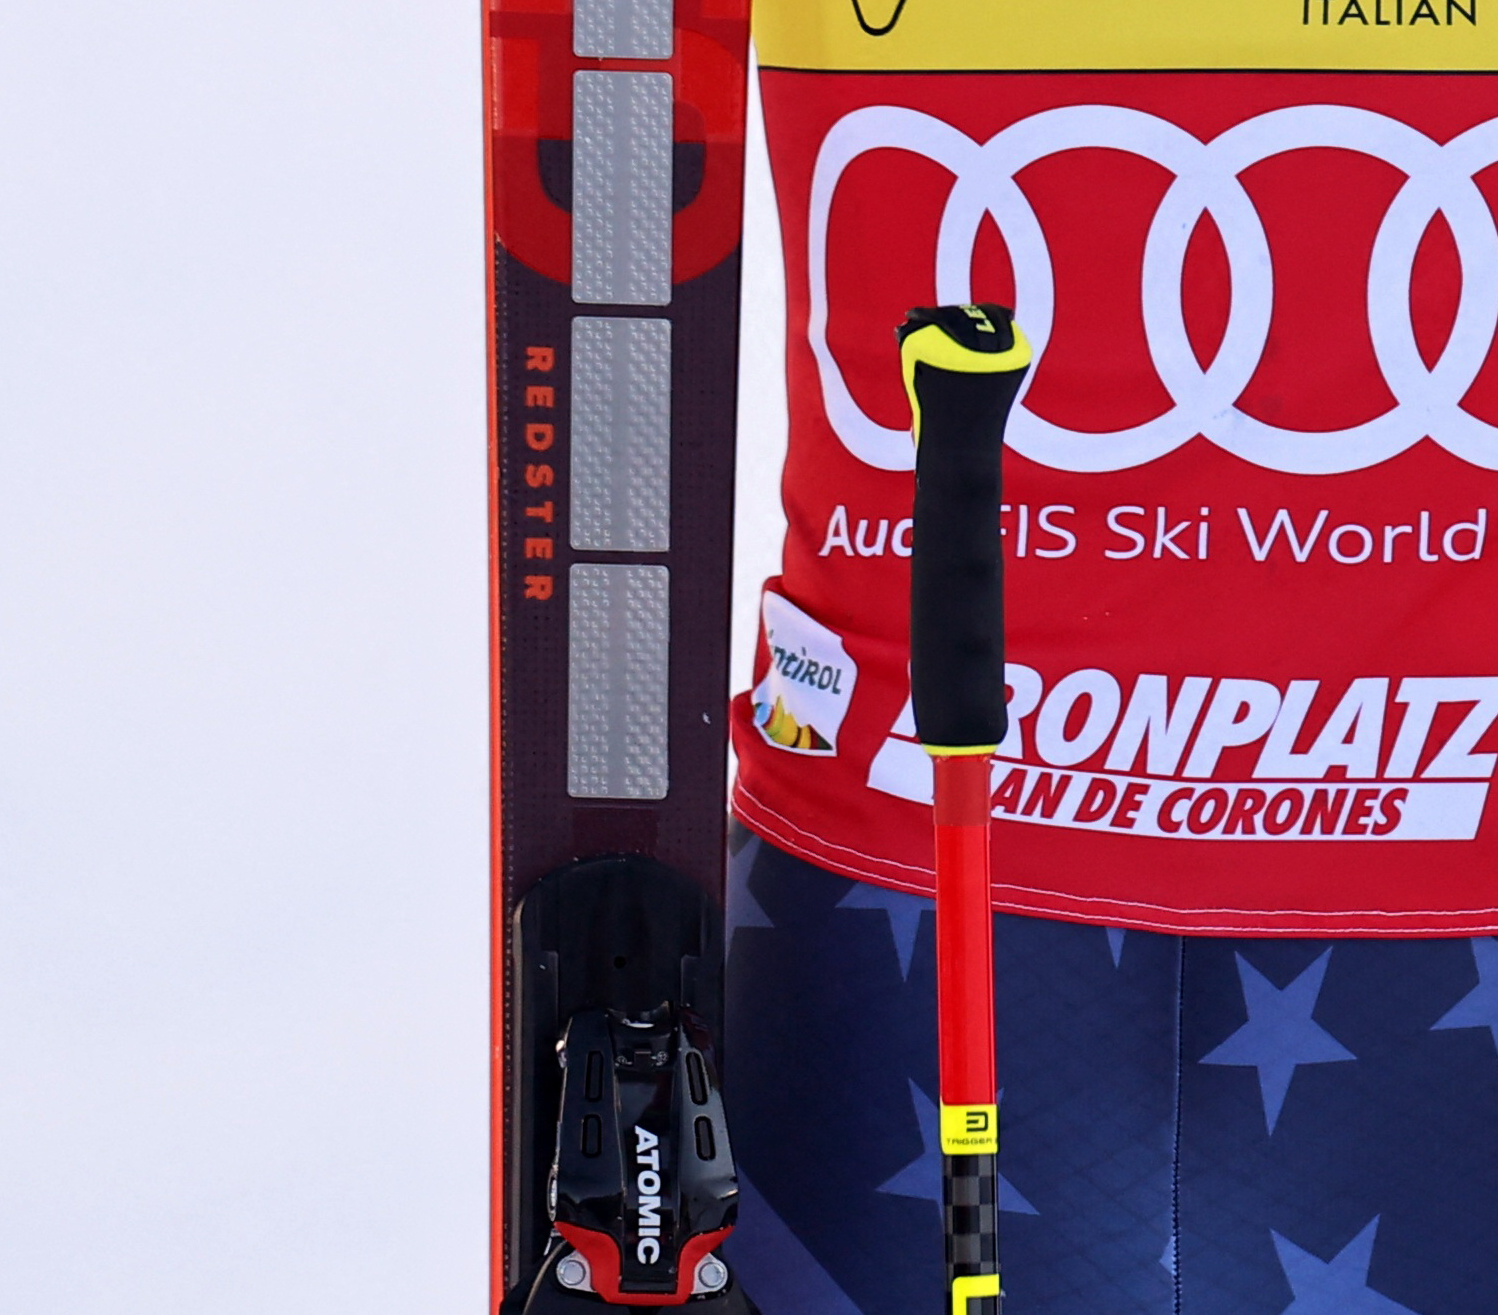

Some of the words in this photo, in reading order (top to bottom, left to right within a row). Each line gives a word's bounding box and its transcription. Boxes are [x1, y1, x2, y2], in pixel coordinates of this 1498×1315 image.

[522, 345, 554, 603] REDSTER
[1104, 504, 1210, 560] Ski
[1237, 506, 1487, 564] World
[1073, 775, 1143, 831] DE
[1155, 781, 1409, 838] CORONES
[633, 1124, 662, 1265] ATOMIC
